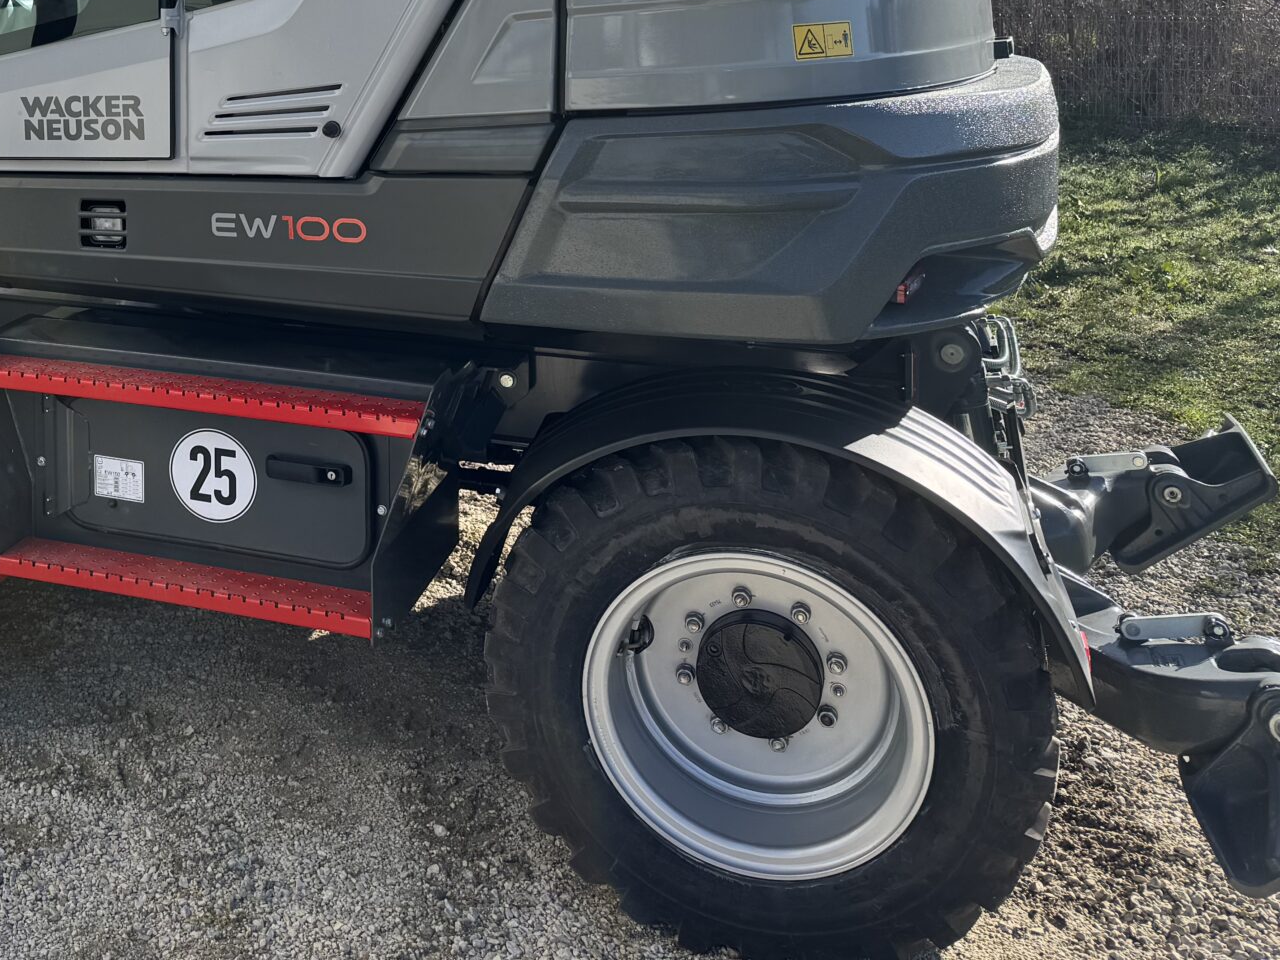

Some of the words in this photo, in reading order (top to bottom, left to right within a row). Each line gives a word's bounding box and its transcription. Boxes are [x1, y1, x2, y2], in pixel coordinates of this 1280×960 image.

[20, 95, 145, 118] WACKER
[24, 119, 145, 141] NEUSON
[211, 212, 367, 243] EW100
[189, 445, 237, 506] 25
